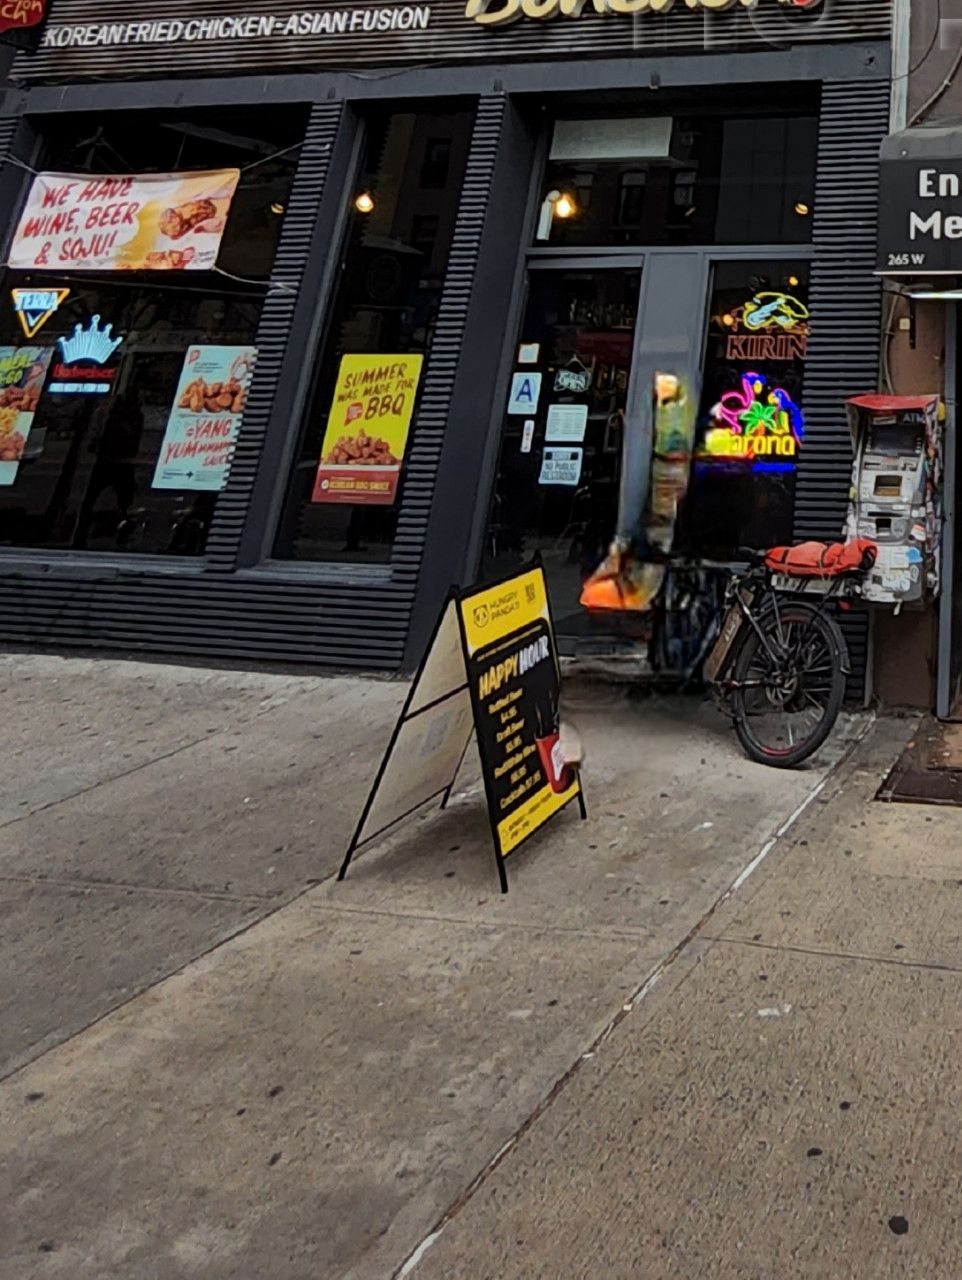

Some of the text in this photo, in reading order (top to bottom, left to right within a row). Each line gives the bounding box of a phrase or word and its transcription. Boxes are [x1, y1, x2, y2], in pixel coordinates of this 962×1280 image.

[43, 25, 122, 47] KOREAN
[123, 22, 183, 43] FRIED
[349, 7, 431, 30] FUSION
[42, 176, 136, 208] WE HAVE
[22, 202, 140, 238] WINE, BEER
[34, 230, 118, 265] & SOJU!
[887, 253, 909, 266] 265
[912, 253, 925, 265] W
[726, 334, 808, 360] KIRIN
[515, 378, 533, 402] A
[364, 393, 406, 420] BBQ
[479, 652, 519, 701] HAPPY
